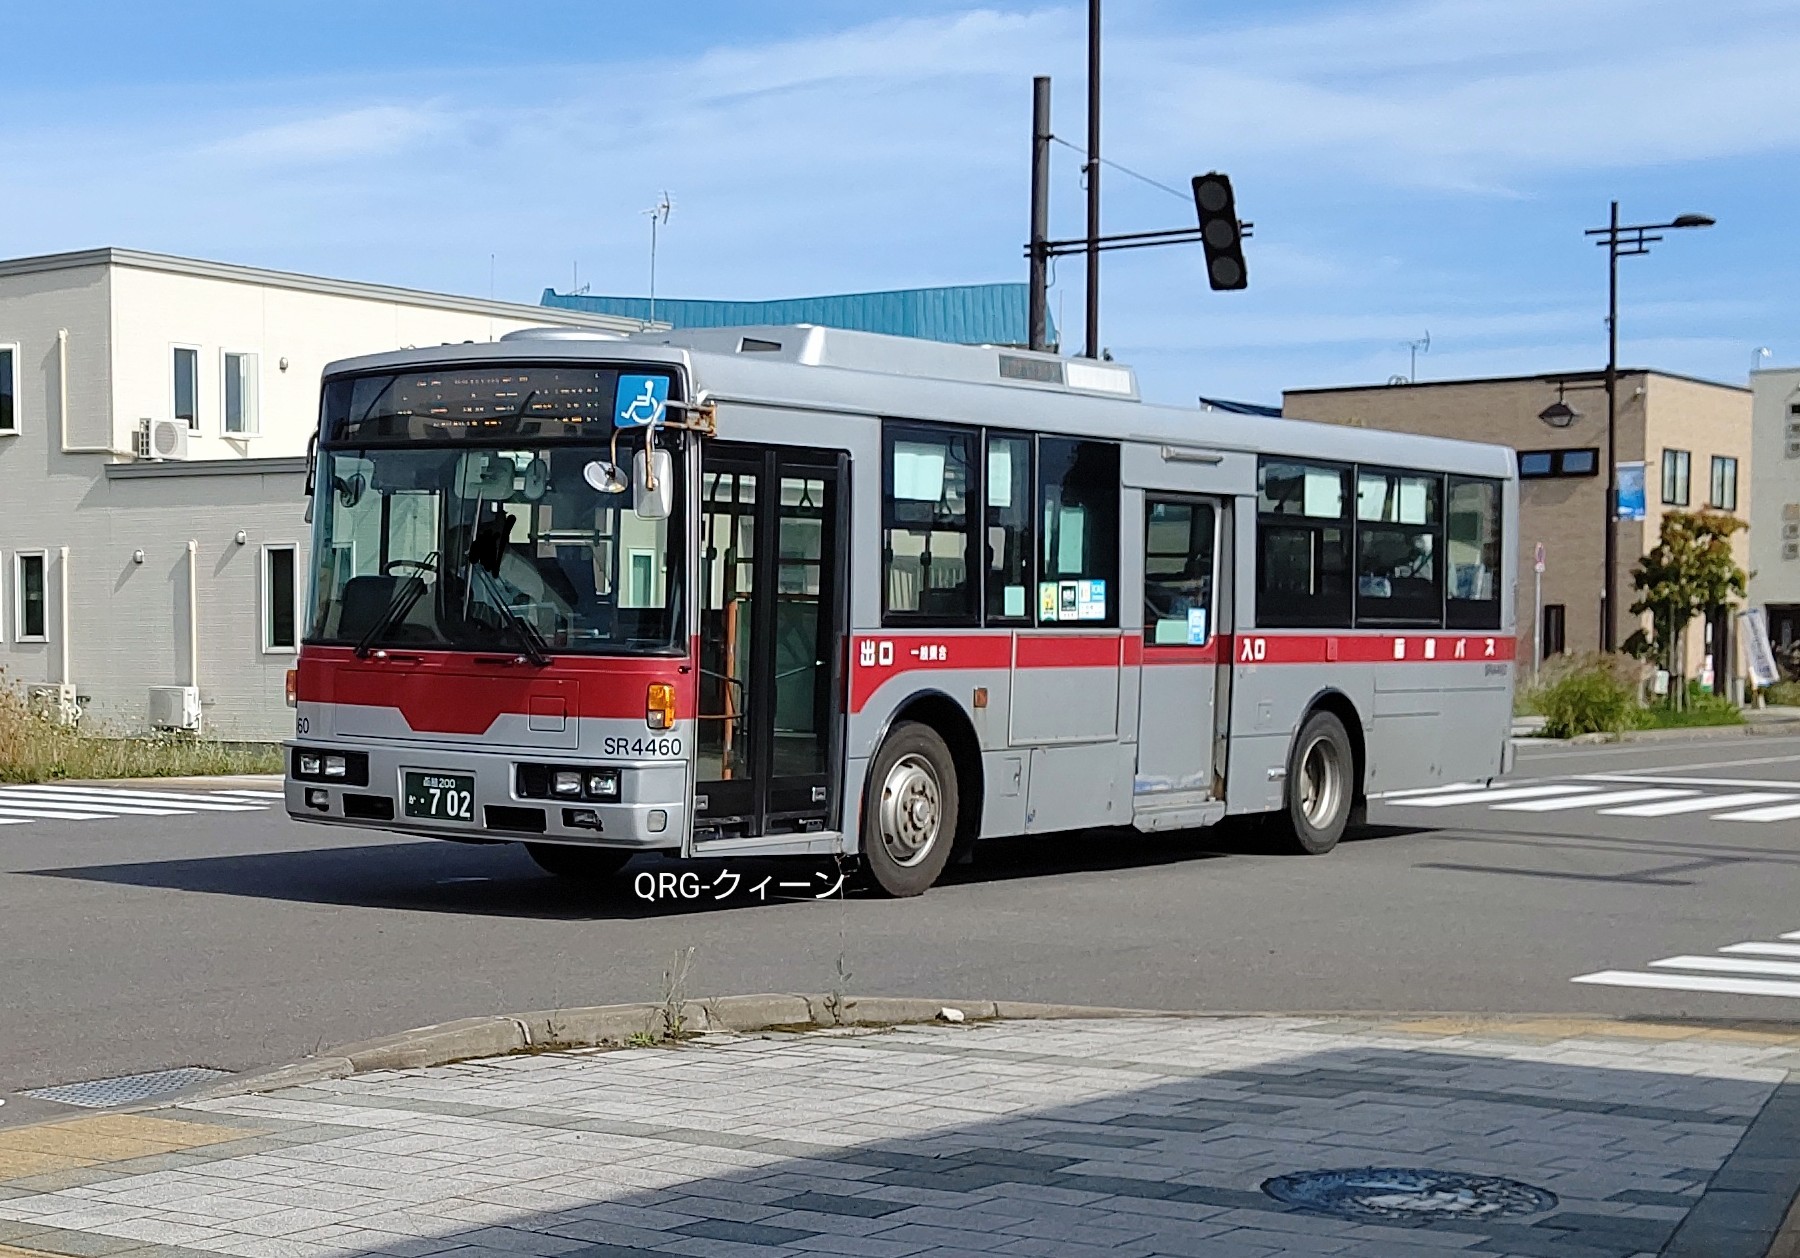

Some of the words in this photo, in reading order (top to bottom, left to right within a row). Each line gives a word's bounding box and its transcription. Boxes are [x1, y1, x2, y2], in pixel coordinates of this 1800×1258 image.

[860, 639, 894, 667] 出口
[1240, 638, 1266, 662] 入口
[297, 717, 310, 734] 60
[604, 737, 682, 756] SR4460
